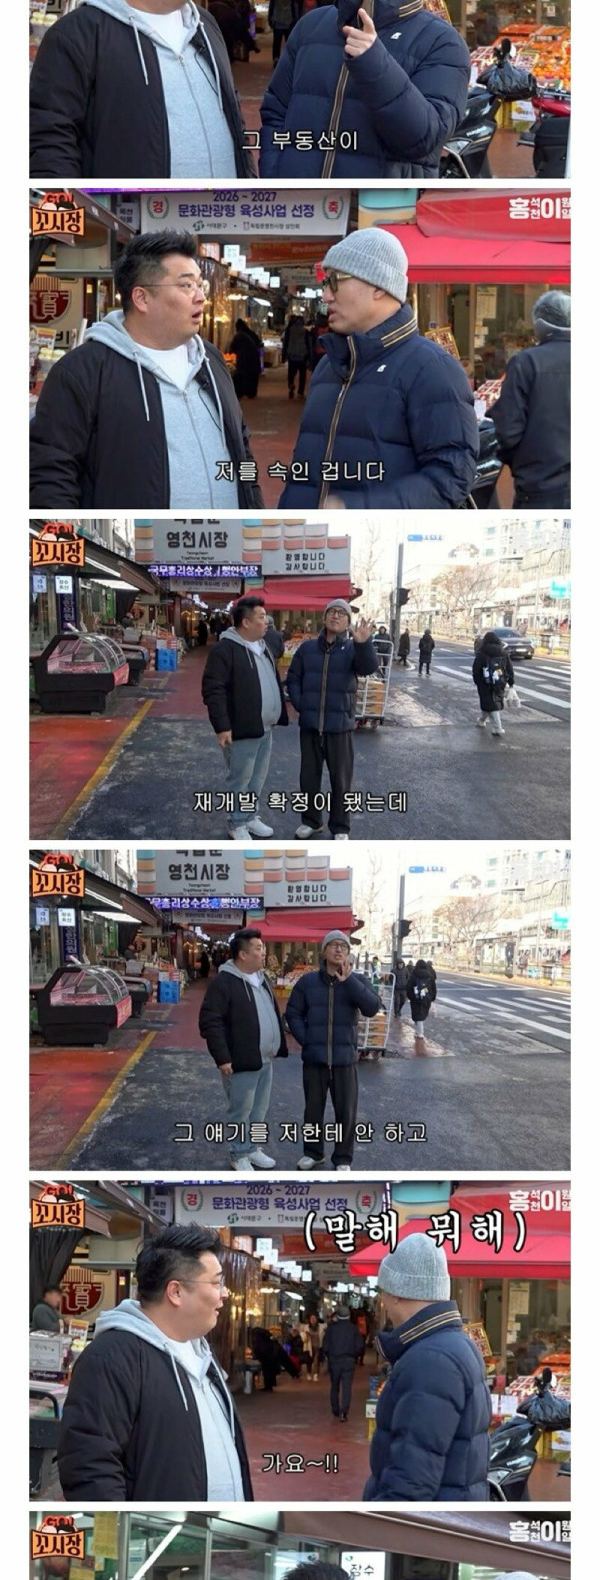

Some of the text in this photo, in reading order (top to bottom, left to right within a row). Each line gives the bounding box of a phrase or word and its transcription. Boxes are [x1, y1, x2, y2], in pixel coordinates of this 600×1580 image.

[213, 192, 276, 202] 2026 2027
[178, 204, 315, 218] 문화관광형 육성사업 선정
[166, 531, 228, 549] 영천시장
[168, 863, 230, 881] 영천시장
